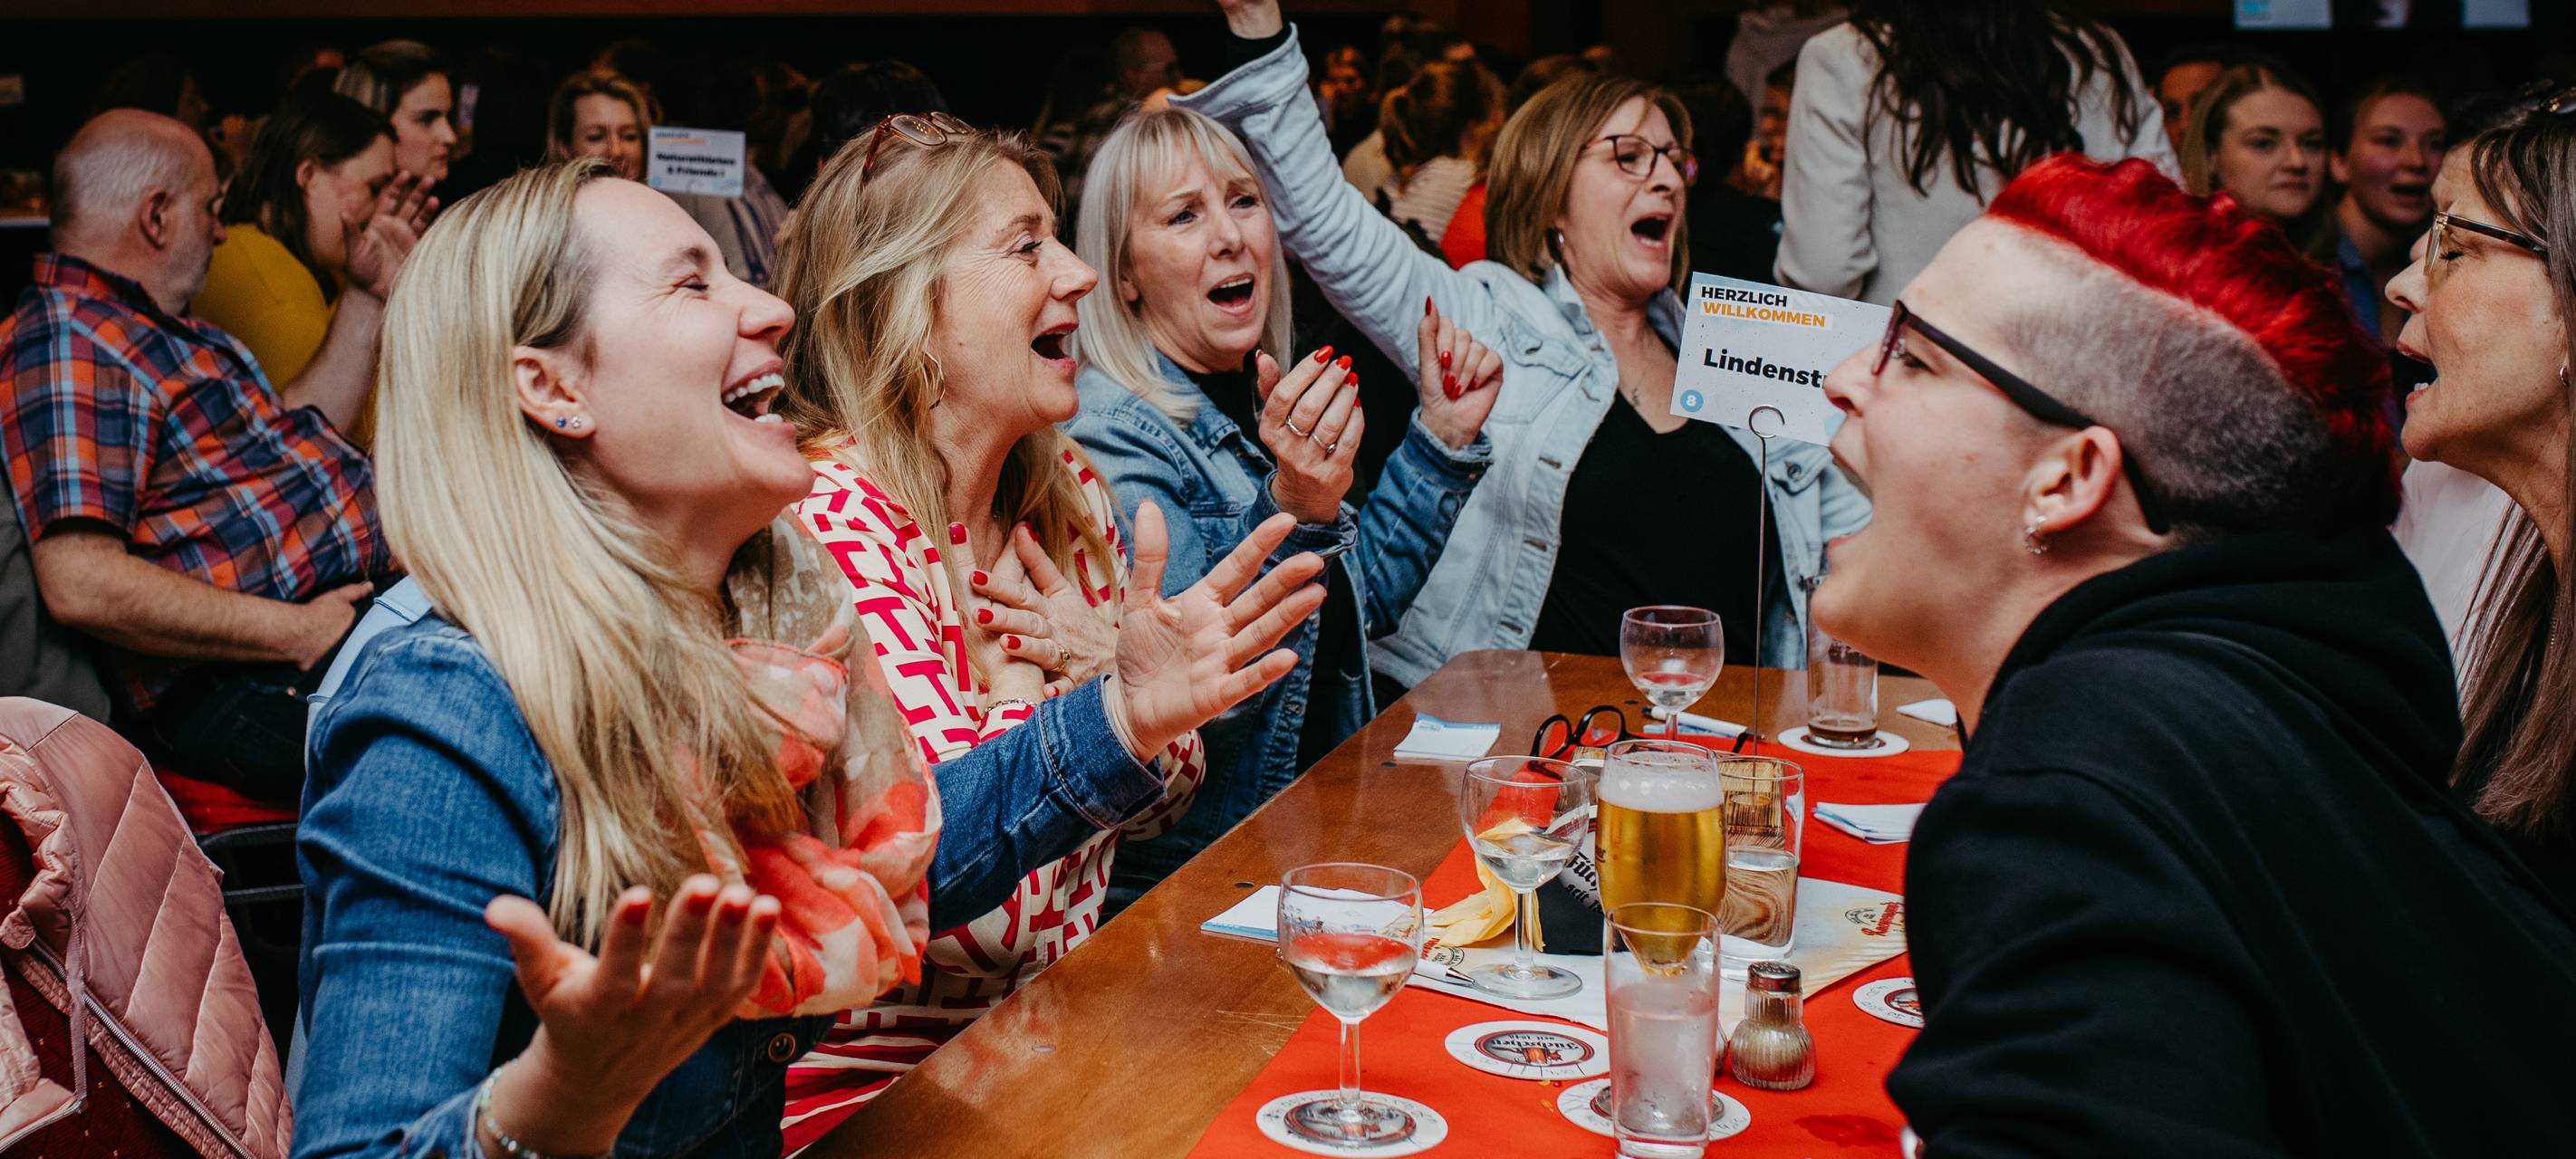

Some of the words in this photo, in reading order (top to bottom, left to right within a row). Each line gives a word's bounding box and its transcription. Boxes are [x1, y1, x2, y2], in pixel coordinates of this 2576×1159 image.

[1701, 286, 1788, 307] HERZLICH
[1703, 301, 1825, 328] WILLKOMMEN
[1703, 348, 1826, 389] Lindenst
[1686, 395, 1697, 407] 8
